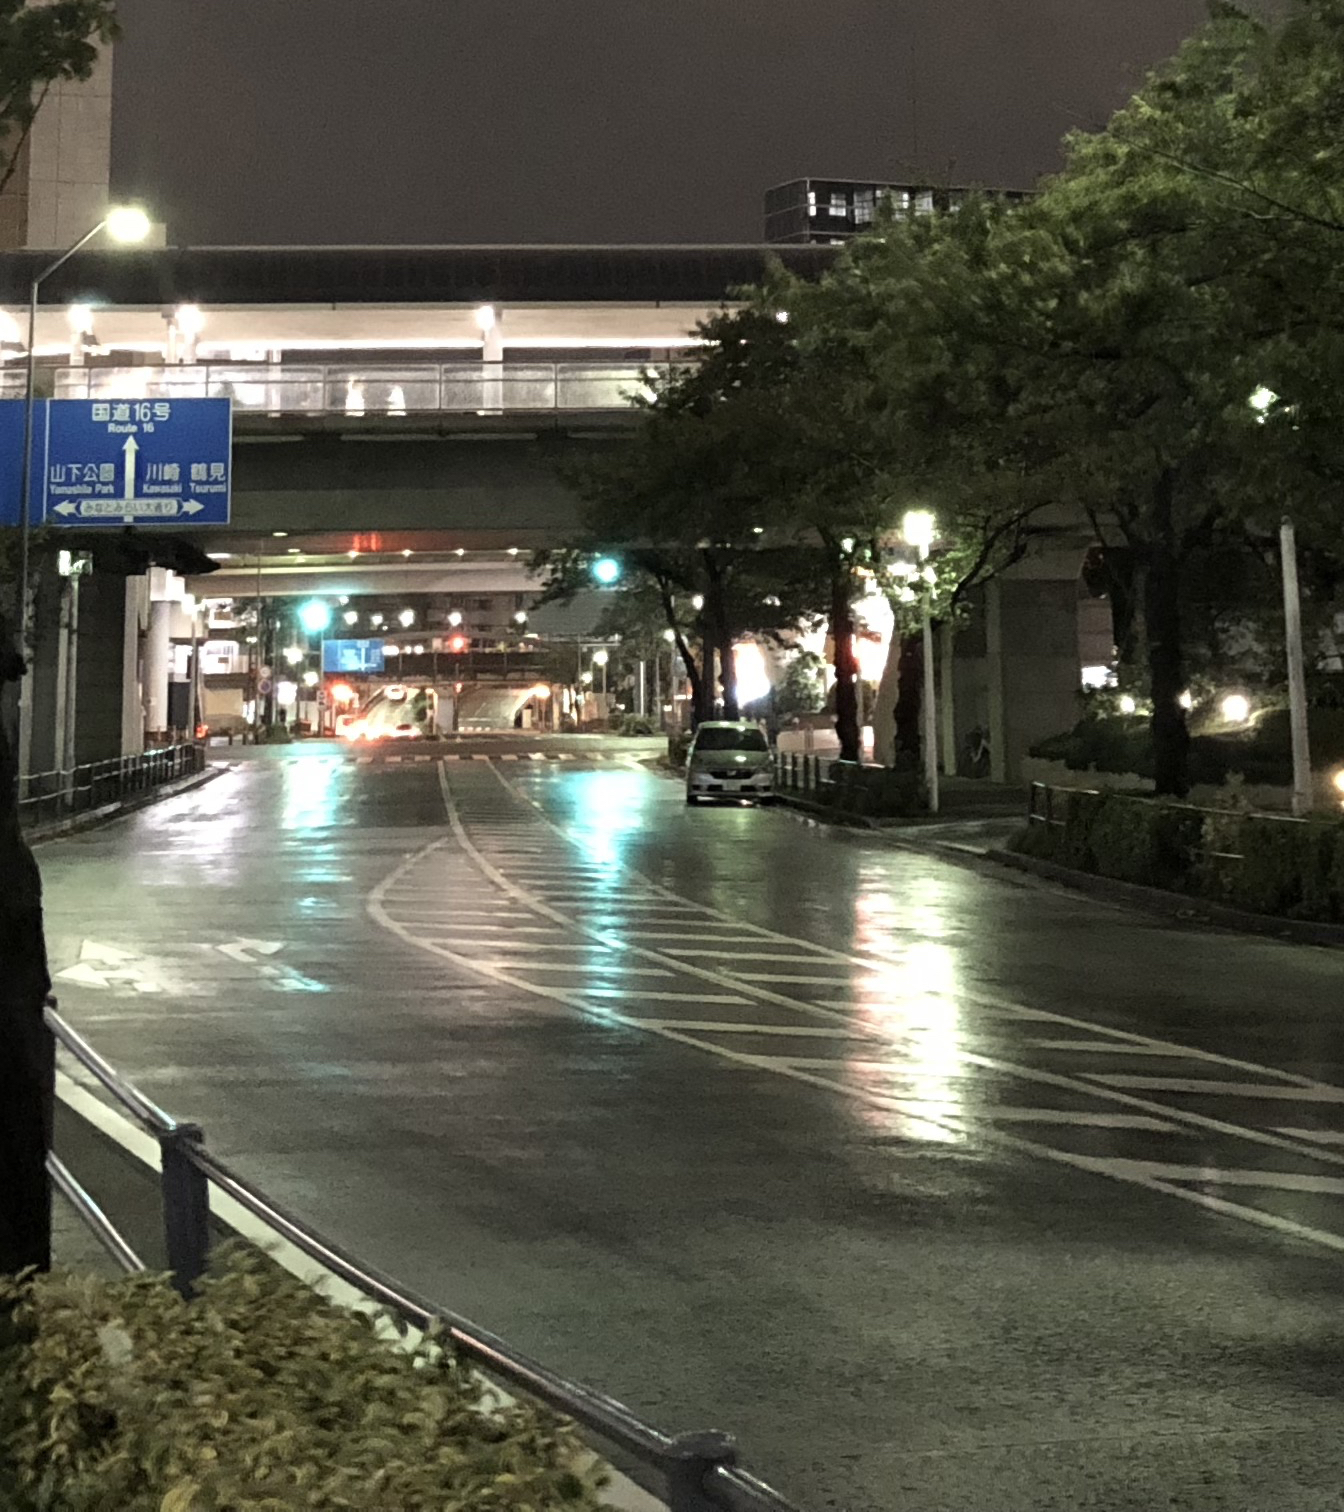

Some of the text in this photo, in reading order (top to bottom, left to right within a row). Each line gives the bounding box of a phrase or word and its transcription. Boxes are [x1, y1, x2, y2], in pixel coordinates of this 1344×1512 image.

[92, 402, 171, 422] 国道16号
[107, 423, 154, 433] Route 16
[50, 463, 115, 482] 山下公園
[146, 462, 226, 481] 川崎 鶴見
[95, 484, 115, 494] Park
[142, 483, 227, 493] Kawasaki Tsurumi
